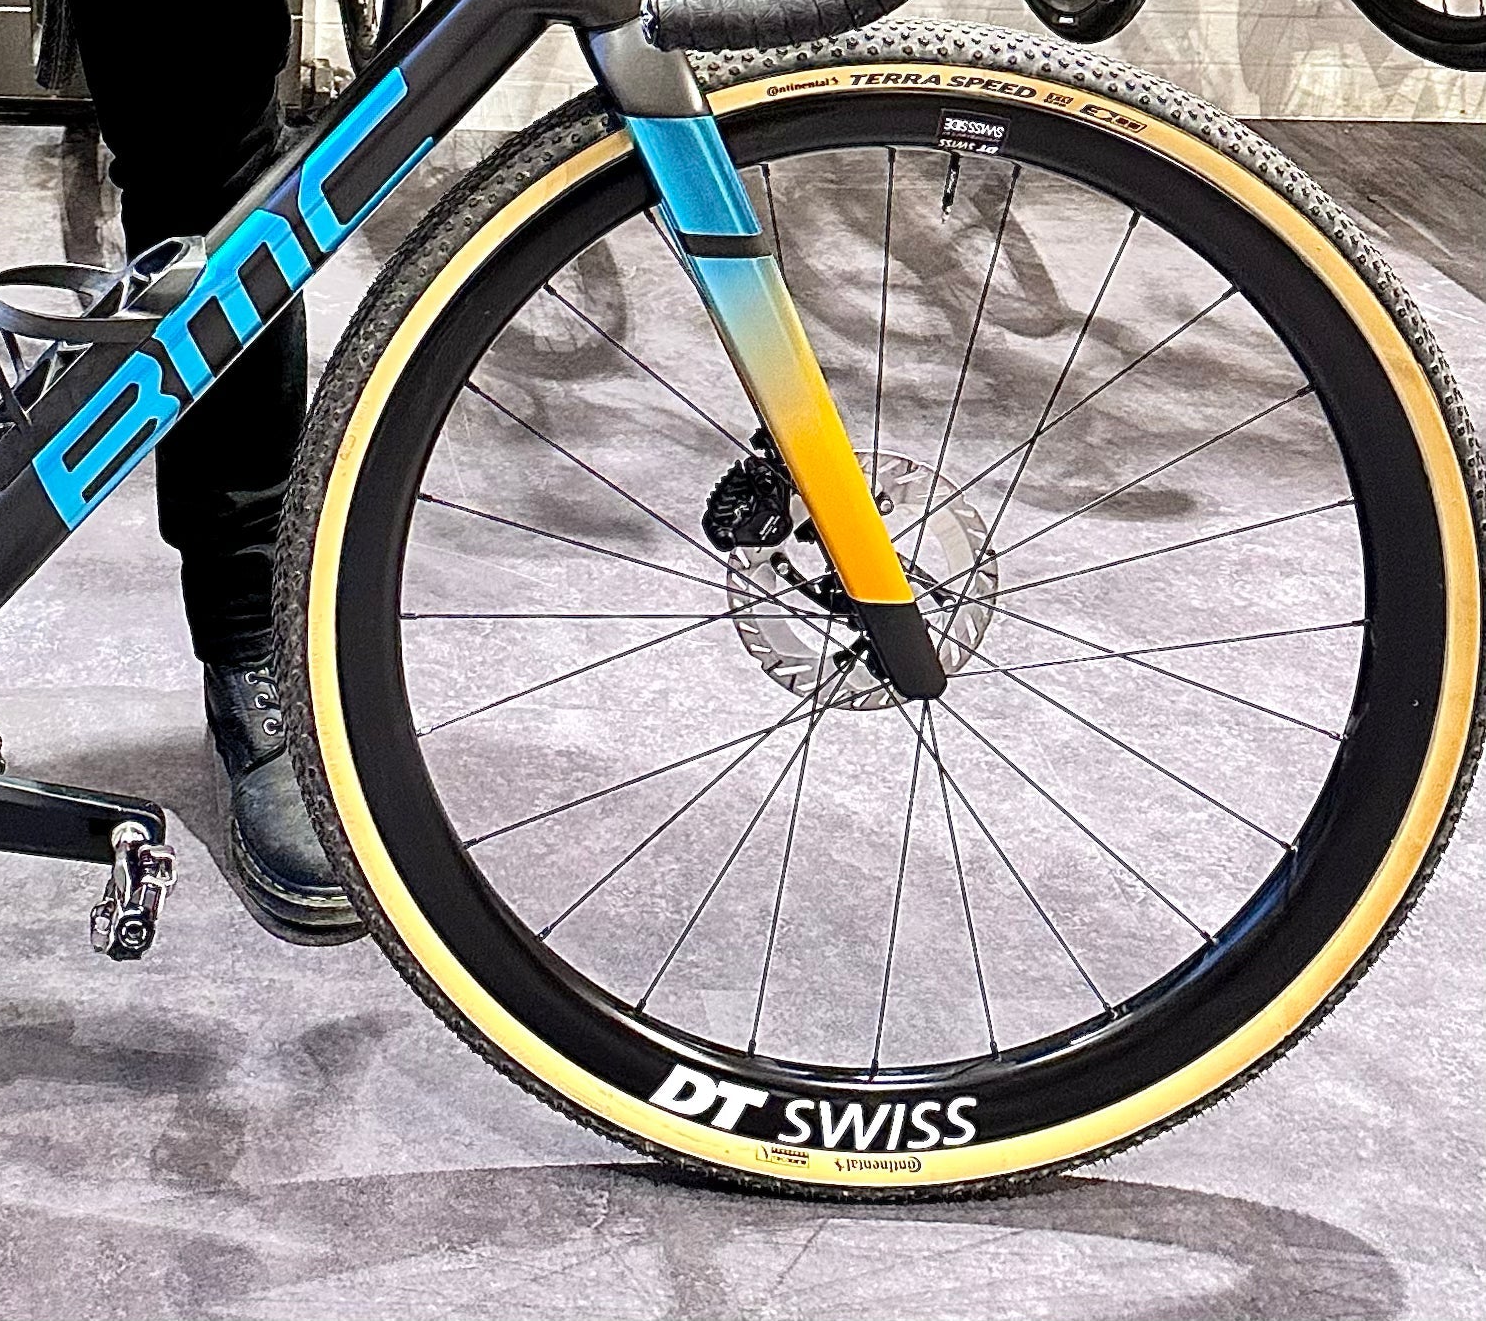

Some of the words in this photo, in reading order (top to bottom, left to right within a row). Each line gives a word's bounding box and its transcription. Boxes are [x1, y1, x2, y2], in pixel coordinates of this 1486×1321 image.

[766, 75, 830, 97] Continental
[849, 72, 943, 87] TERRA
[946, 74, 1038, 99] SPEED
[938, 137, 974, 151] SWISS
[32, 66, 434, 532] BMC
[648, 1063, 770, 1132] DT
[777, 1096, 978, 1152] SWISS
